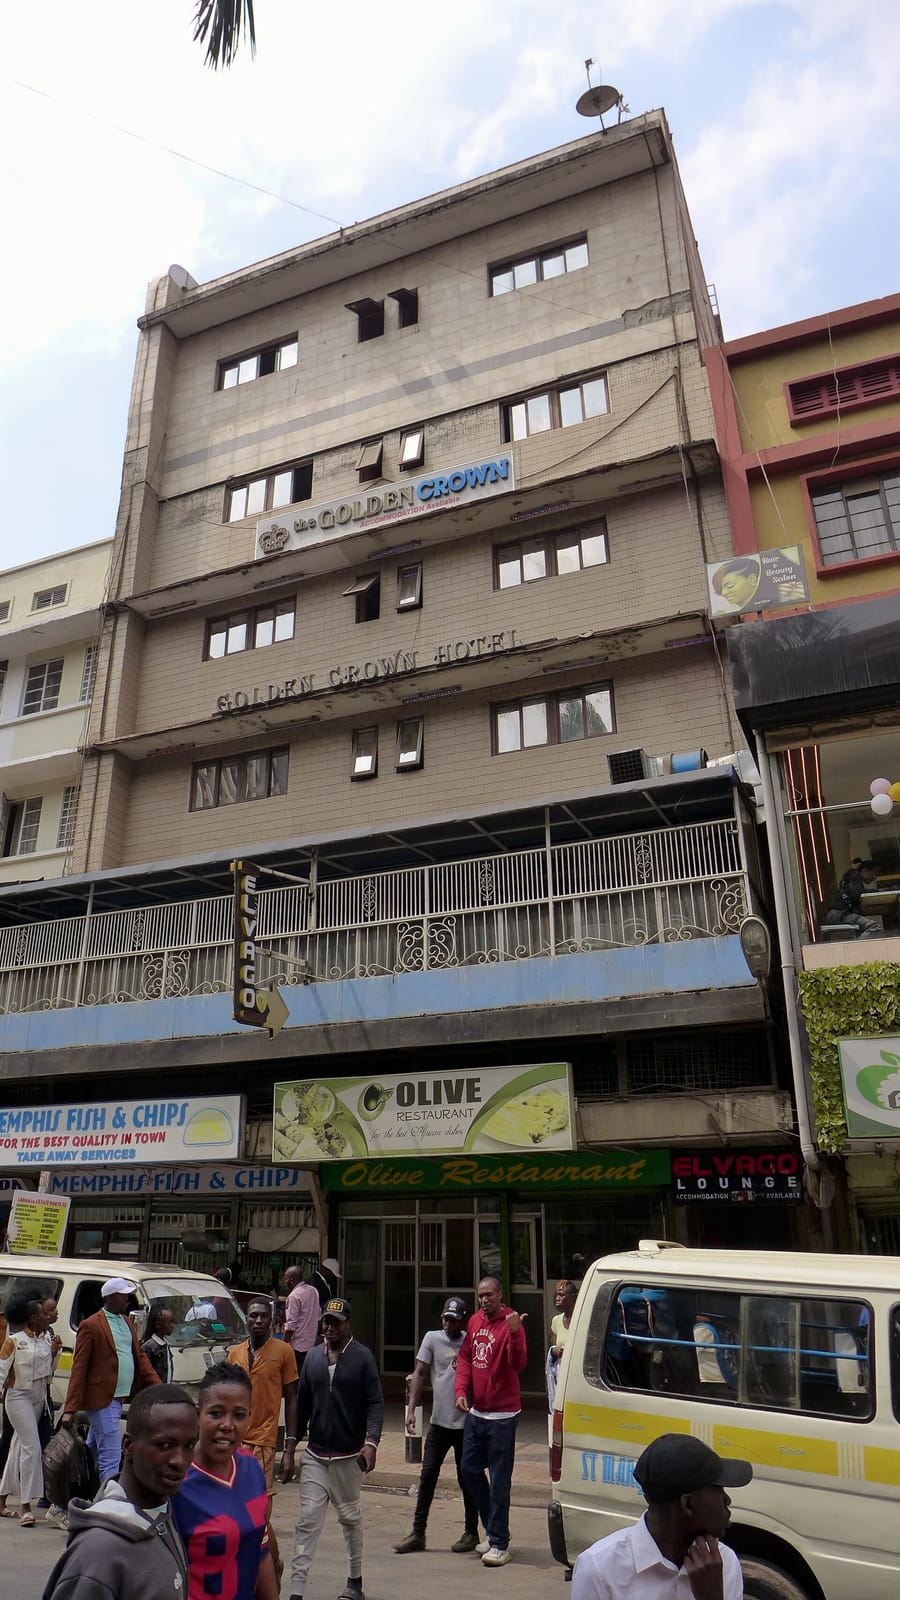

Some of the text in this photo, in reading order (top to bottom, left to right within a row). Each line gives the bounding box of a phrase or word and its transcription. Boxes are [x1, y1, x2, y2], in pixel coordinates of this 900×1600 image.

[293, 458, 509, 532] the GOLDEN CROWN
[359, 496, 461, 529] ACCOMMODATION Available
[761, 556, 779, 564] Hair
[765, 566, 793, 577] Beauty
[772, 574, 797, 584] Salon
[216, 629, 524, 711] GOLDEN CROWN HOTEL
[240, 874, 257, 1009] ELVAGO
[395, 1077, 482, 1107] OLIVE
[66, 1106, 107, 1131] FISH
[112, 1105, 127, 1130] &
[132, 1102, 190, 1128] CHIPS
[396, 1108, 475, 1122] RESTAURANT
[21, 1137, 40, 1149] THE
[43, 1135, 70, 1148] BEST
[72, 1133, 119, 1147] QUALITY
[121, 1132, 132, 1144] IN
[135, 1131, 167, 1144] TOWN
[369, 1128, 382, 1143] for
[383, 1127, 393, 1138] the
[396, 1127, 407, 1138] best
[410, 1124, 442, 1141] African
[16, 1148, 137, 1162] TAKE AWAY SERVICES
[51, 1168, 300, 1193] MEMPHIS FISH & CHIPS
[341, 1157, 646, 1187] Olive Restaurant
[677, 1176, 797, 1190] LOUNGE
[582, 1452, 598, 1481] ST
